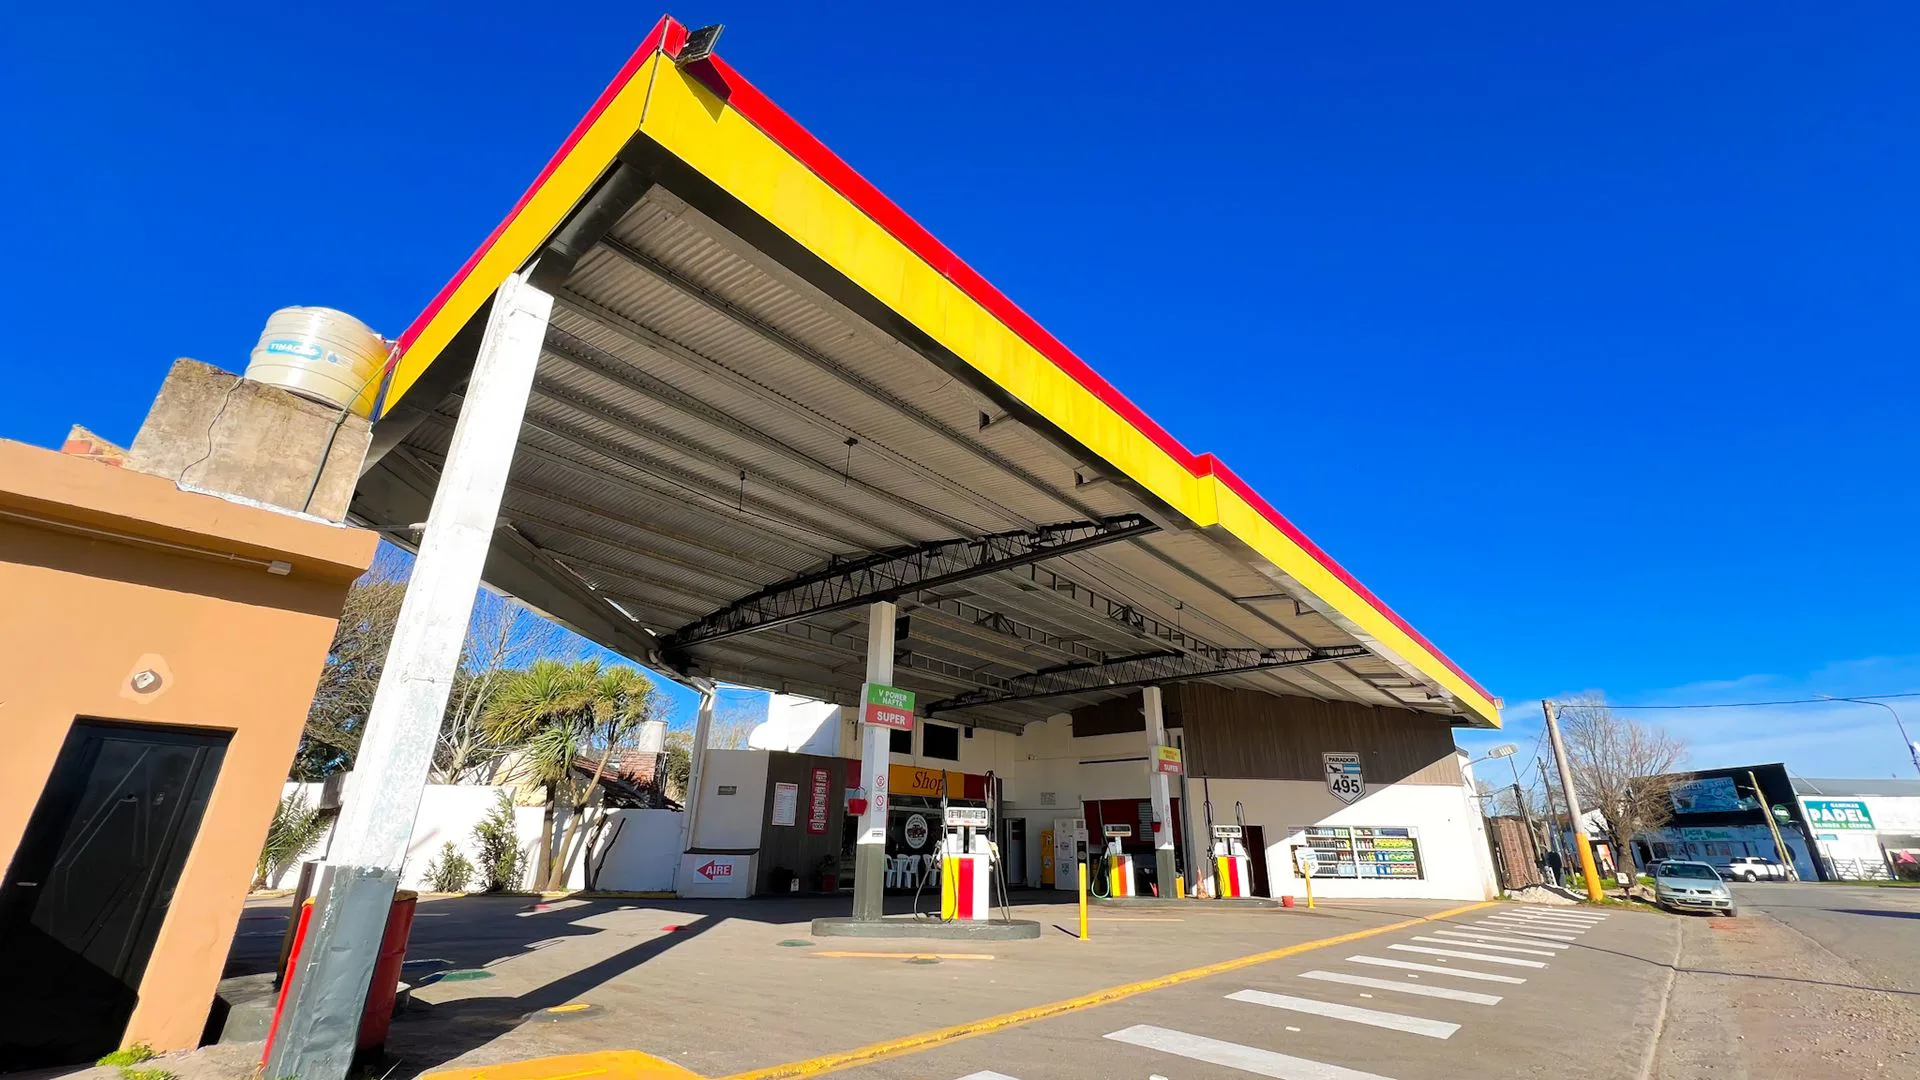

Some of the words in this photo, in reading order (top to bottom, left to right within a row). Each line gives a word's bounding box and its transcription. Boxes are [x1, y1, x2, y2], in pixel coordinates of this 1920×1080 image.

[878, 689, 884, 697] V
[885, 690, 907, 702] POWER
[882, 697, 903, 707] NAFTA
[877, 711, 906, 725] SUPER
[912, 770, 944, 795] Shop
[1332, 779, 1360, 793] 495
[1808, 803, 1870, 822] PÁDEL
[705, 865, 731, 875] AIRE
